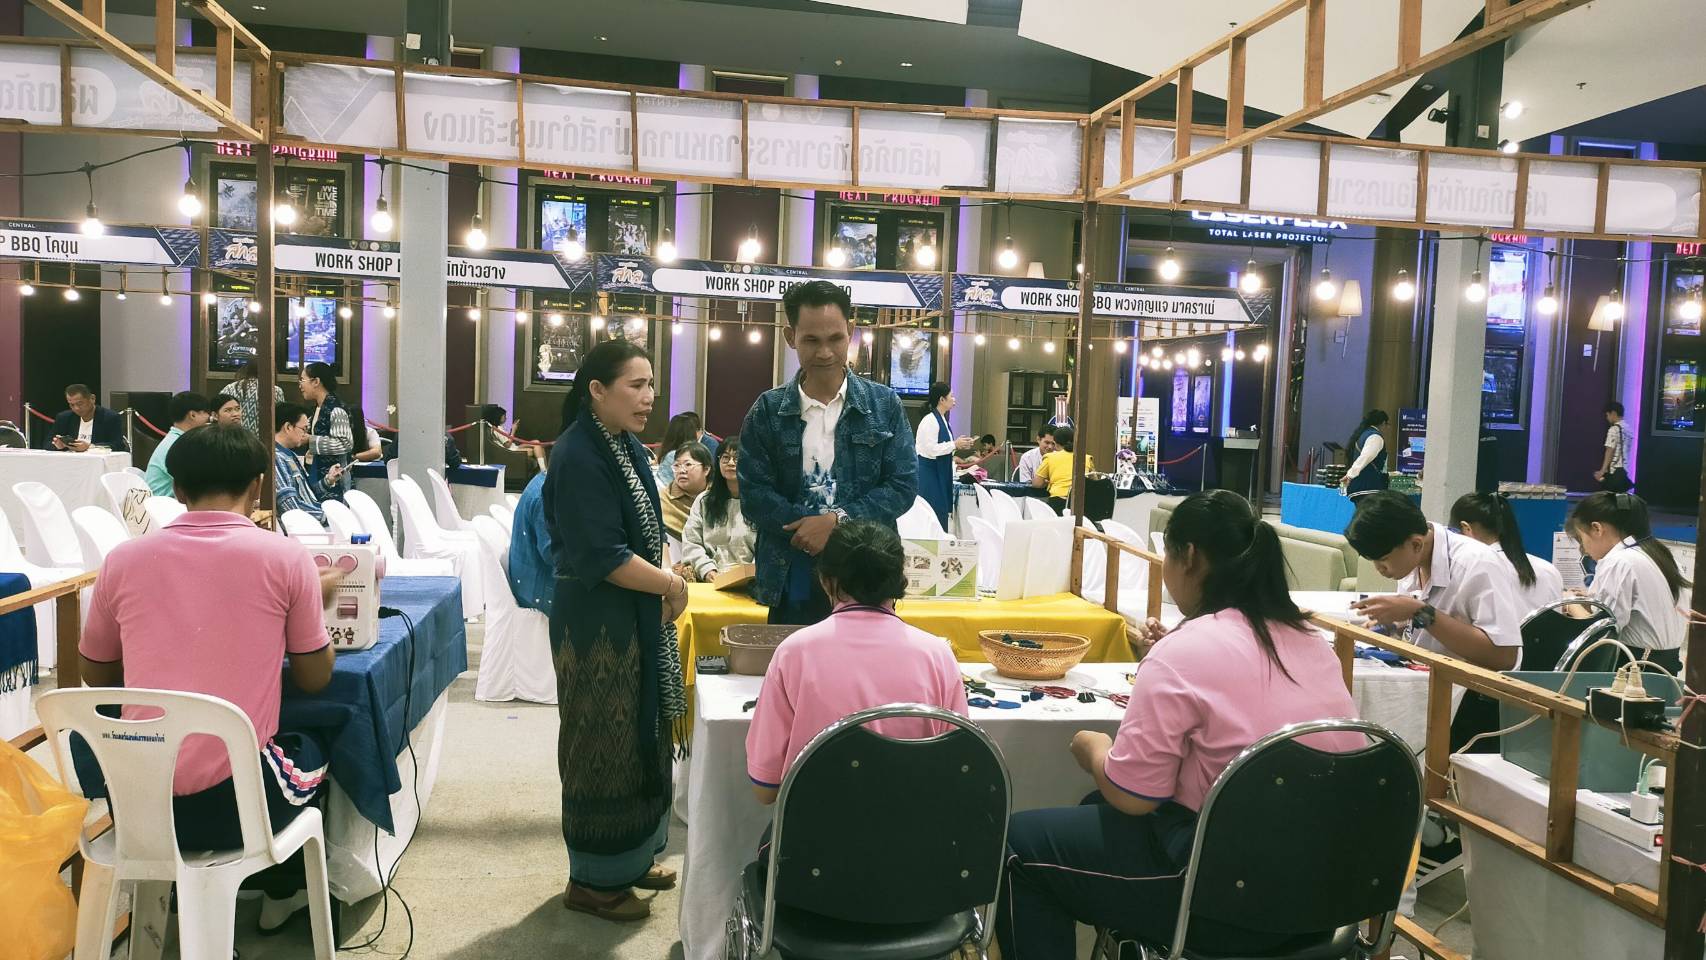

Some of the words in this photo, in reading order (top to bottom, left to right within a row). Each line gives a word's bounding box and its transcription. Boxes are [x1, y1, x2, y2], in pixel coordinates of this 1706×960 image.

[316, 192, 338, 201] LIVE
[1209, 228, 1238, 238] TOTAL
[1242, 231, 1272, 240] LASER
[11, 235, 40, 254] BBQ
[45, 235, 78, 258] โคขุน
[1676, 242, 1701, 256] NEXT
[315, 252, 353, 269] WORK
[358, 255, 393, 272] SHOP
[705, 275, 740, 292] WORK
[744, 278, 775, 294] SHOP
[1021, 291, 1052, 307] WORK
[1115, 299, 1169, 315] พวงกุญแจ
